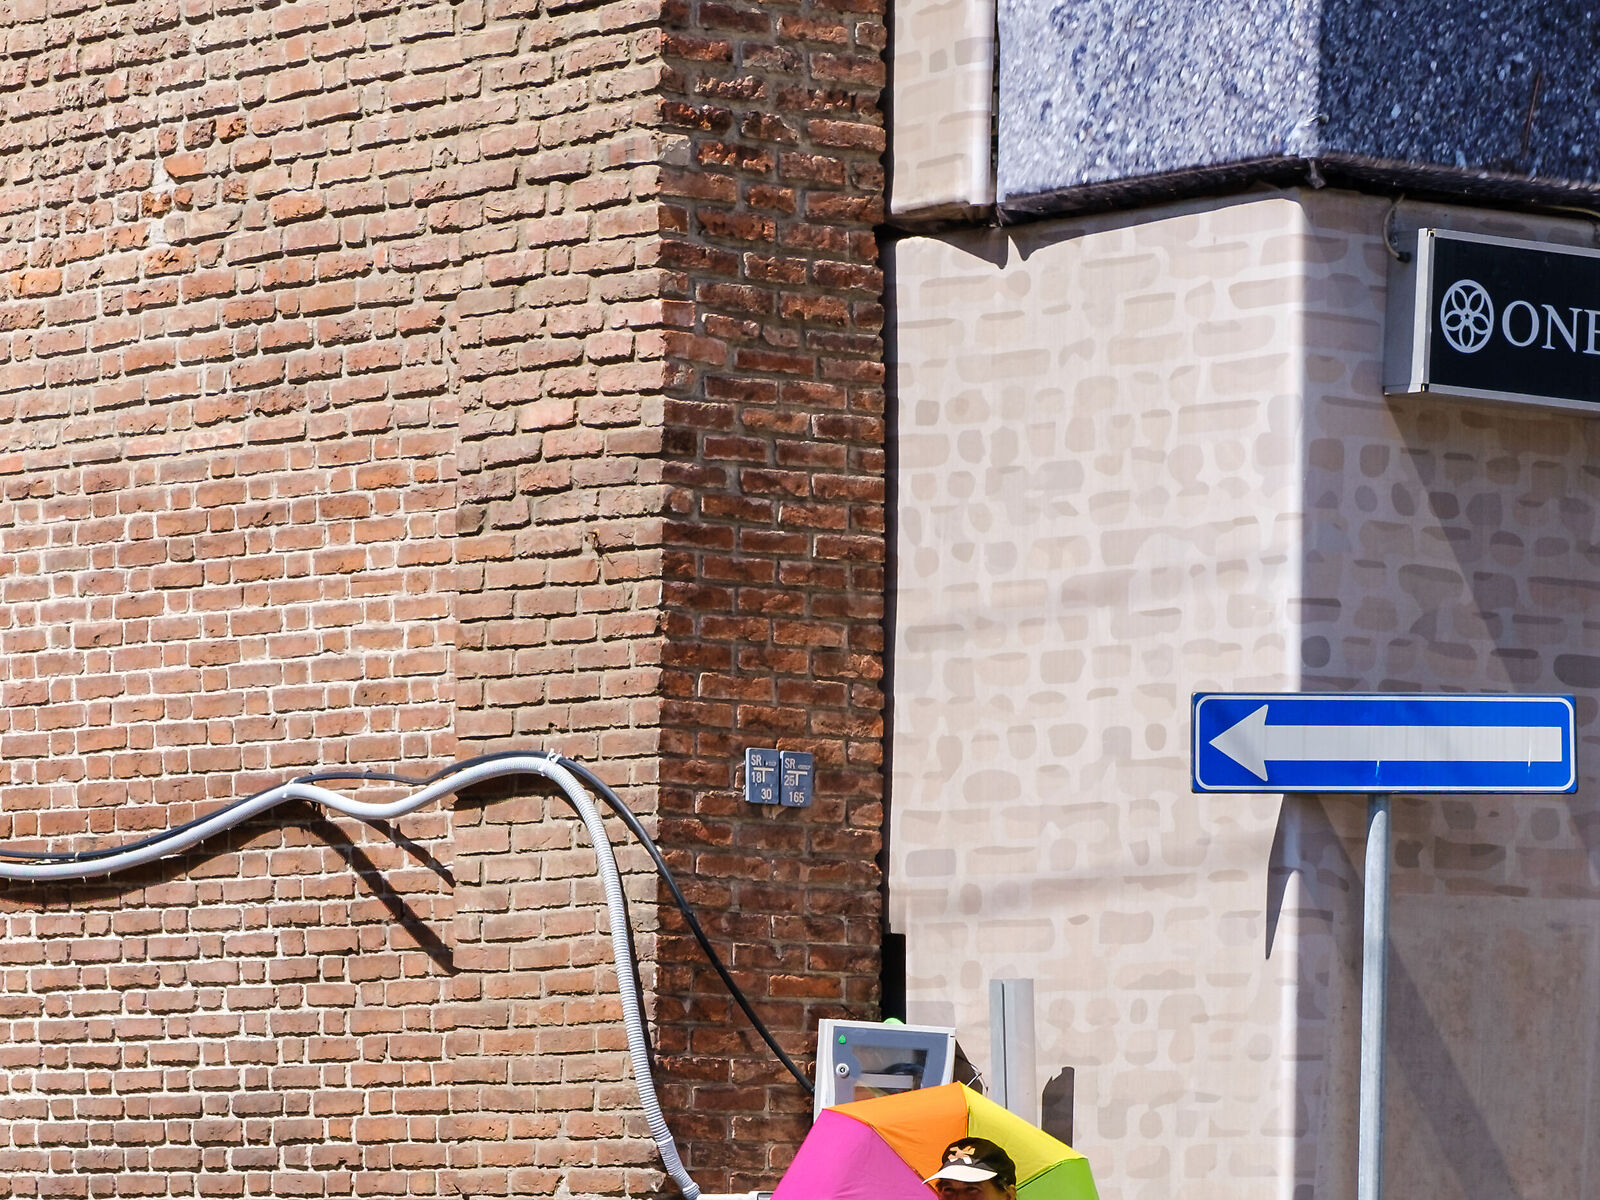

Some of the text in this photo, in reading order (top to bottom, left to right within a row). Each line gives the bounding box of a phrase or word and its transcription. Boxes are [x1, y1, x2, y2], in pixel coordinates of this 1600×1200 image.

[1502, 300, 1600, 355] ONE
[751, 754, 762, 766] SR
[784, 757, 796, 770] SR
[751, 771, 762, 783] 18
[761, 788, 772, 800] 30
[789, 791, 805, 803] 165
